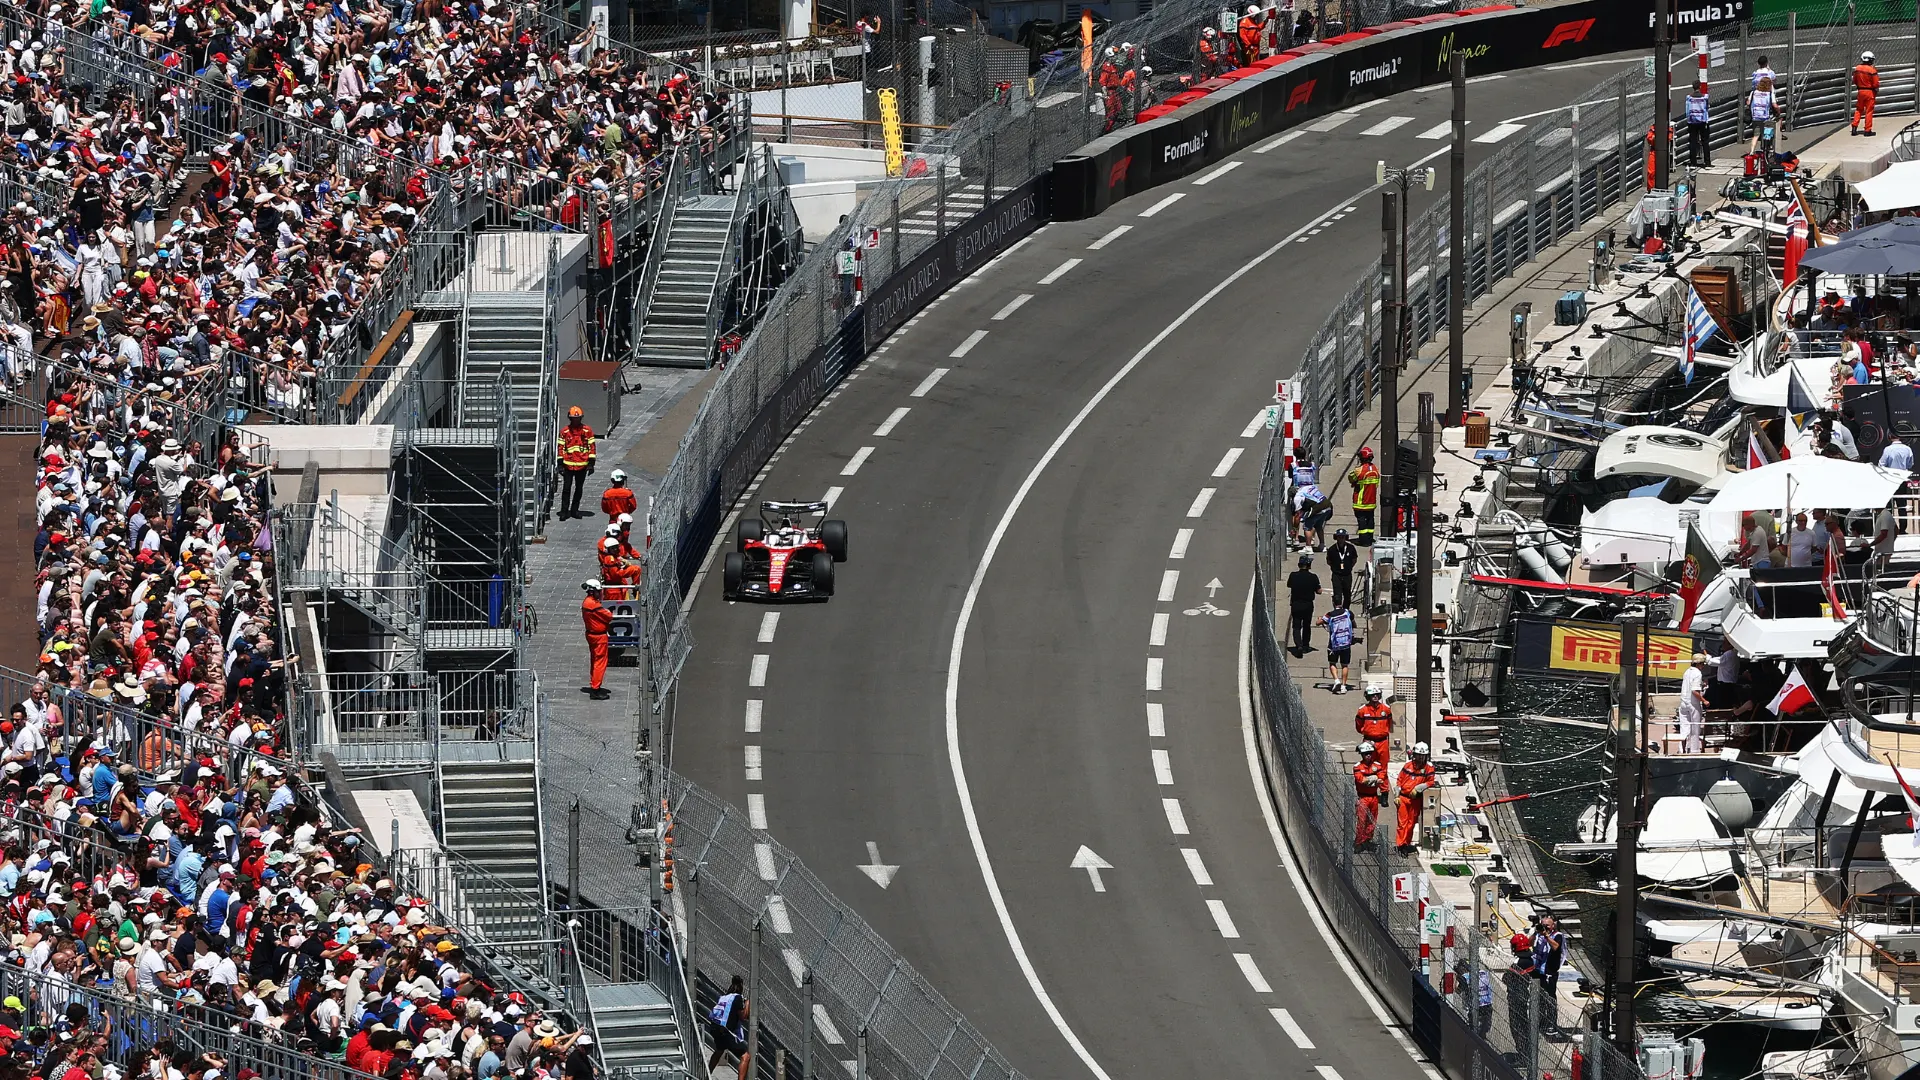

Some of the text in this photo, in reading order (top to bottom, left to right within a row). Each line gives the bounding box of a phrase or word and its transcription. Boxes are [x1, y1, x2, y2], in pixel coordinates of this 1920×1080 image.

[1349, 62, 1391, 87] Formula
[1229, 101, 1260, 144] Monaco
[1164, 135, 1202, 163] Formula
[965, 193, 1036, 260] EXPLORA JOURNEYS
[878, 257, 941, 327] EXPLORA JOURNEYS
